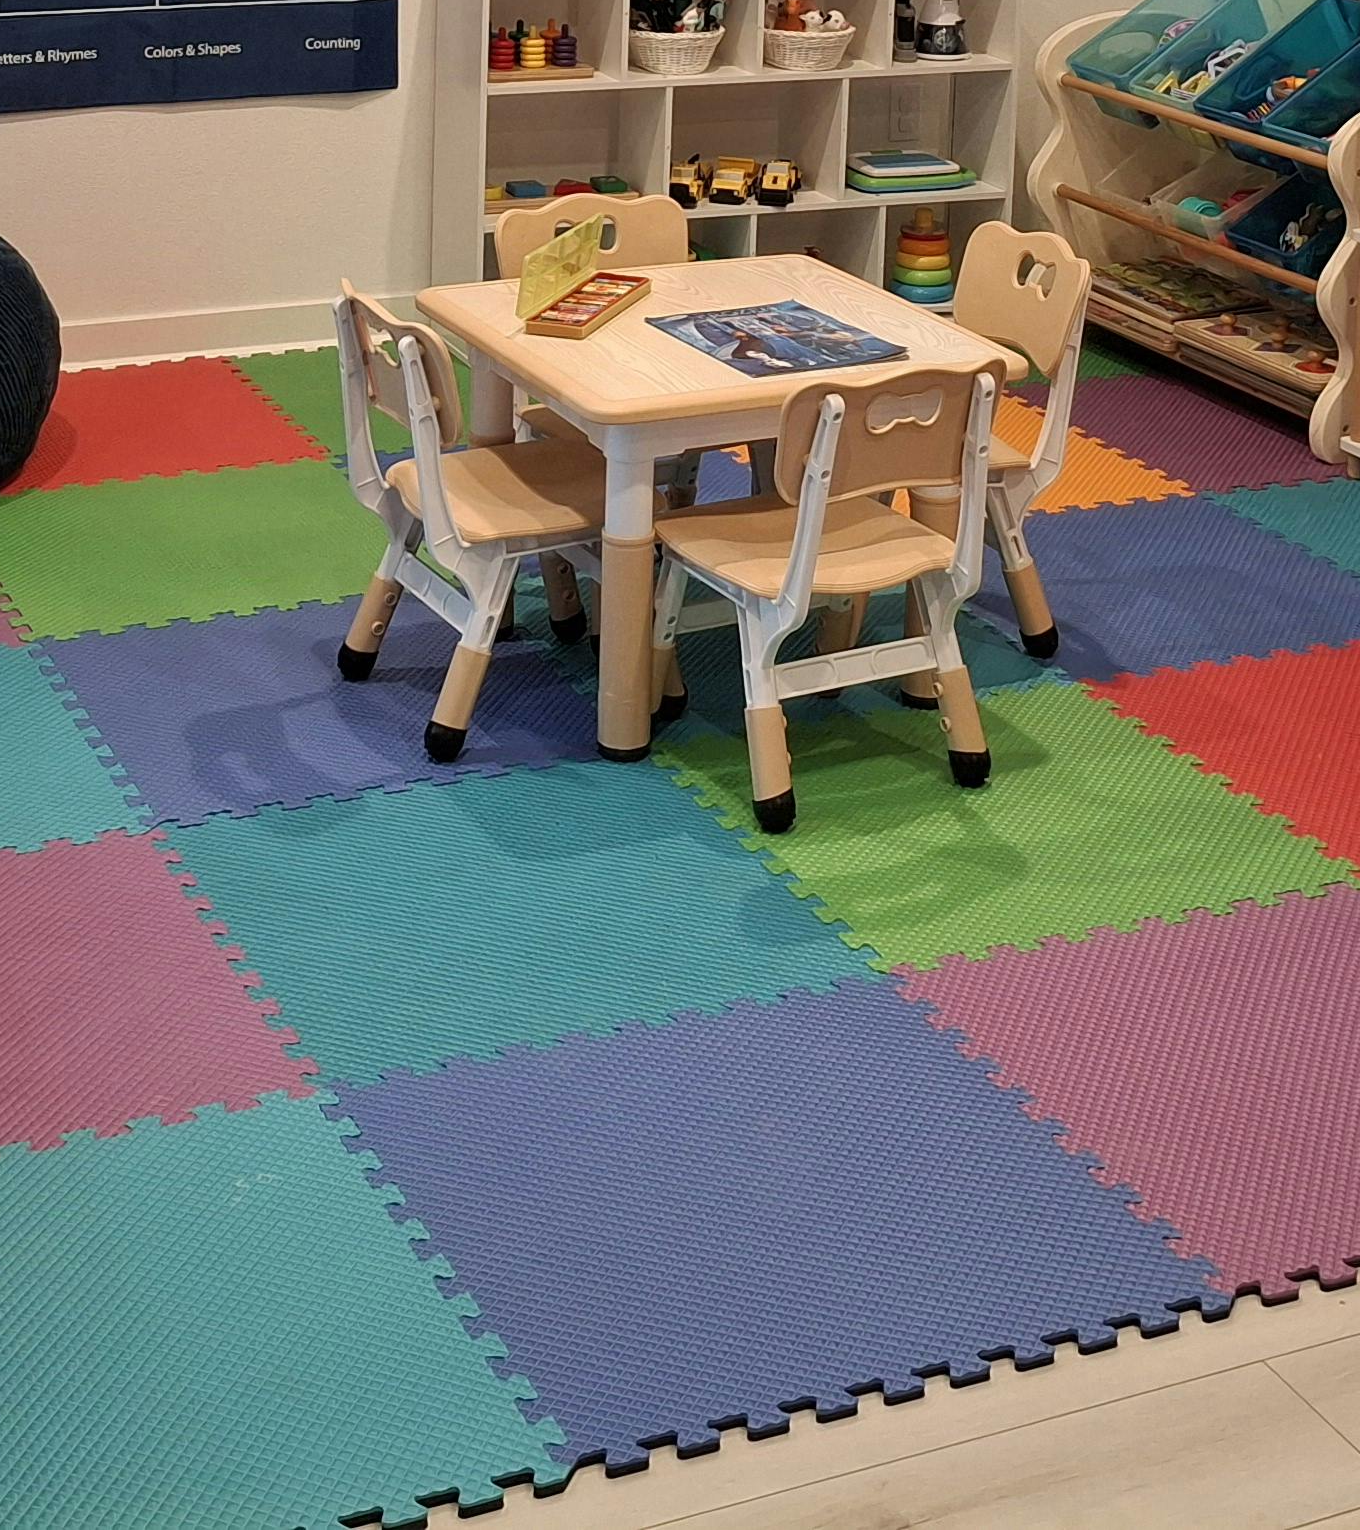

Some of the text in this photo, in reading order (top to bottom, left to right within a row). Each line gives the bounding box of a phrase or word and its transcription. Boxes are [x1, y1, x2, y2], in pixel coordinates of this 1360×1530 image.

[34, 50, 45, 64] &
[48, 46, 97, 64] Rhymes
[144, 44, 183, 60] Colors
[186, 43, 196, 58] &
[198, 40, 241, 58] Shapes
[305, 34, 361, 51] Counting
